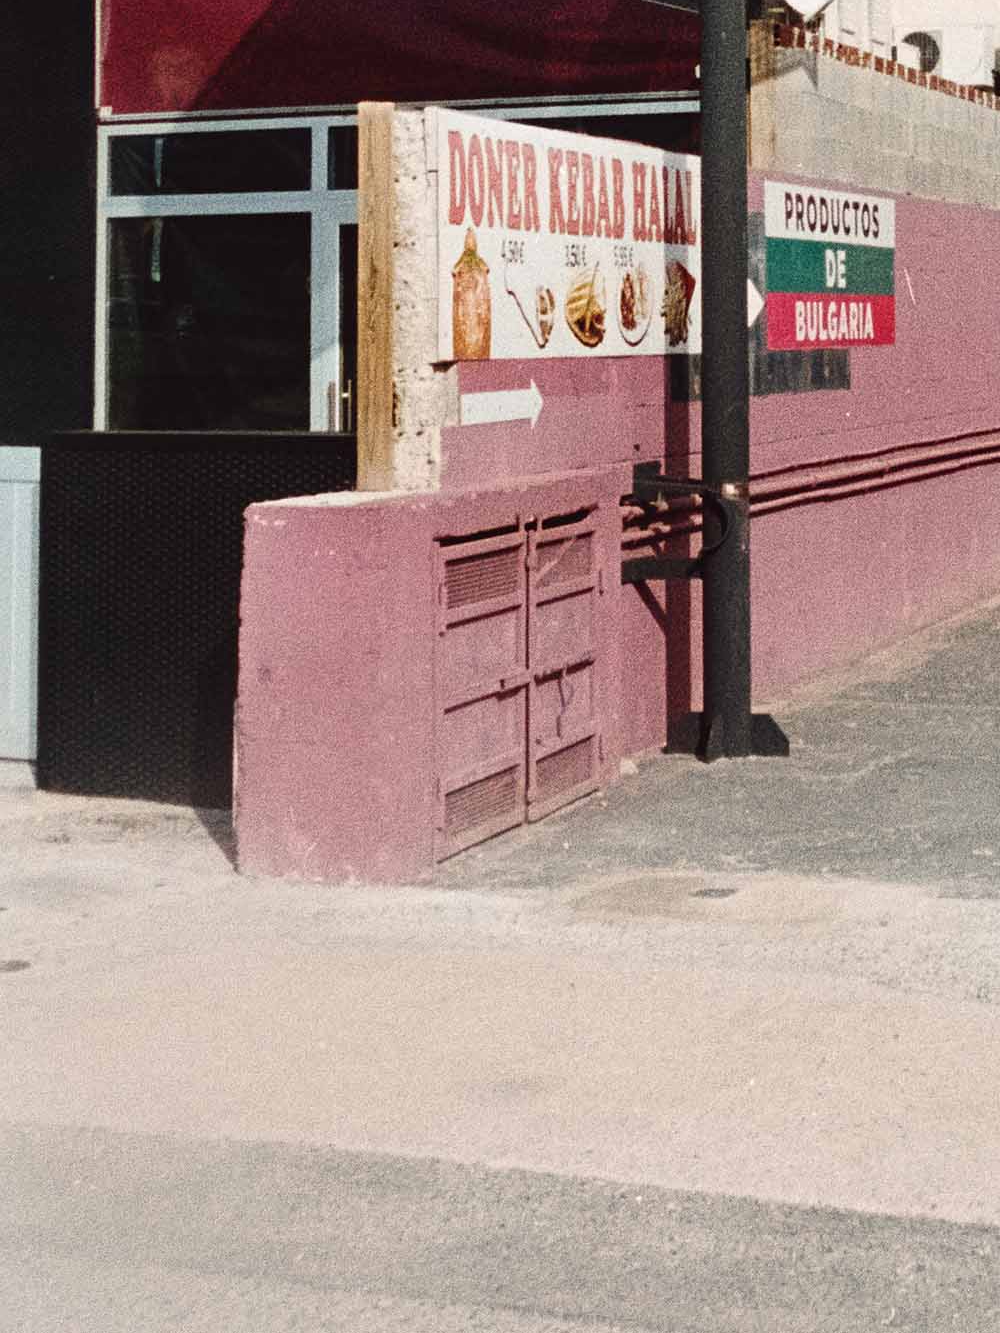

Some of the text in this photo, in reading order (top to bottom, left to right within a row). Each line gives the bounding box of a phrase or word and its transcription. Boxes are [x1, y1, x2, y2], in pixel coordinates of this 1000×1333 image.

[447, 130, 697, 247] DONER KEBAB HALAL
[784, 191, 881, 239] PRODUCTOS
[824, 248, 848, 289] DE
[794, 300, 875, 342] BULGARIA
